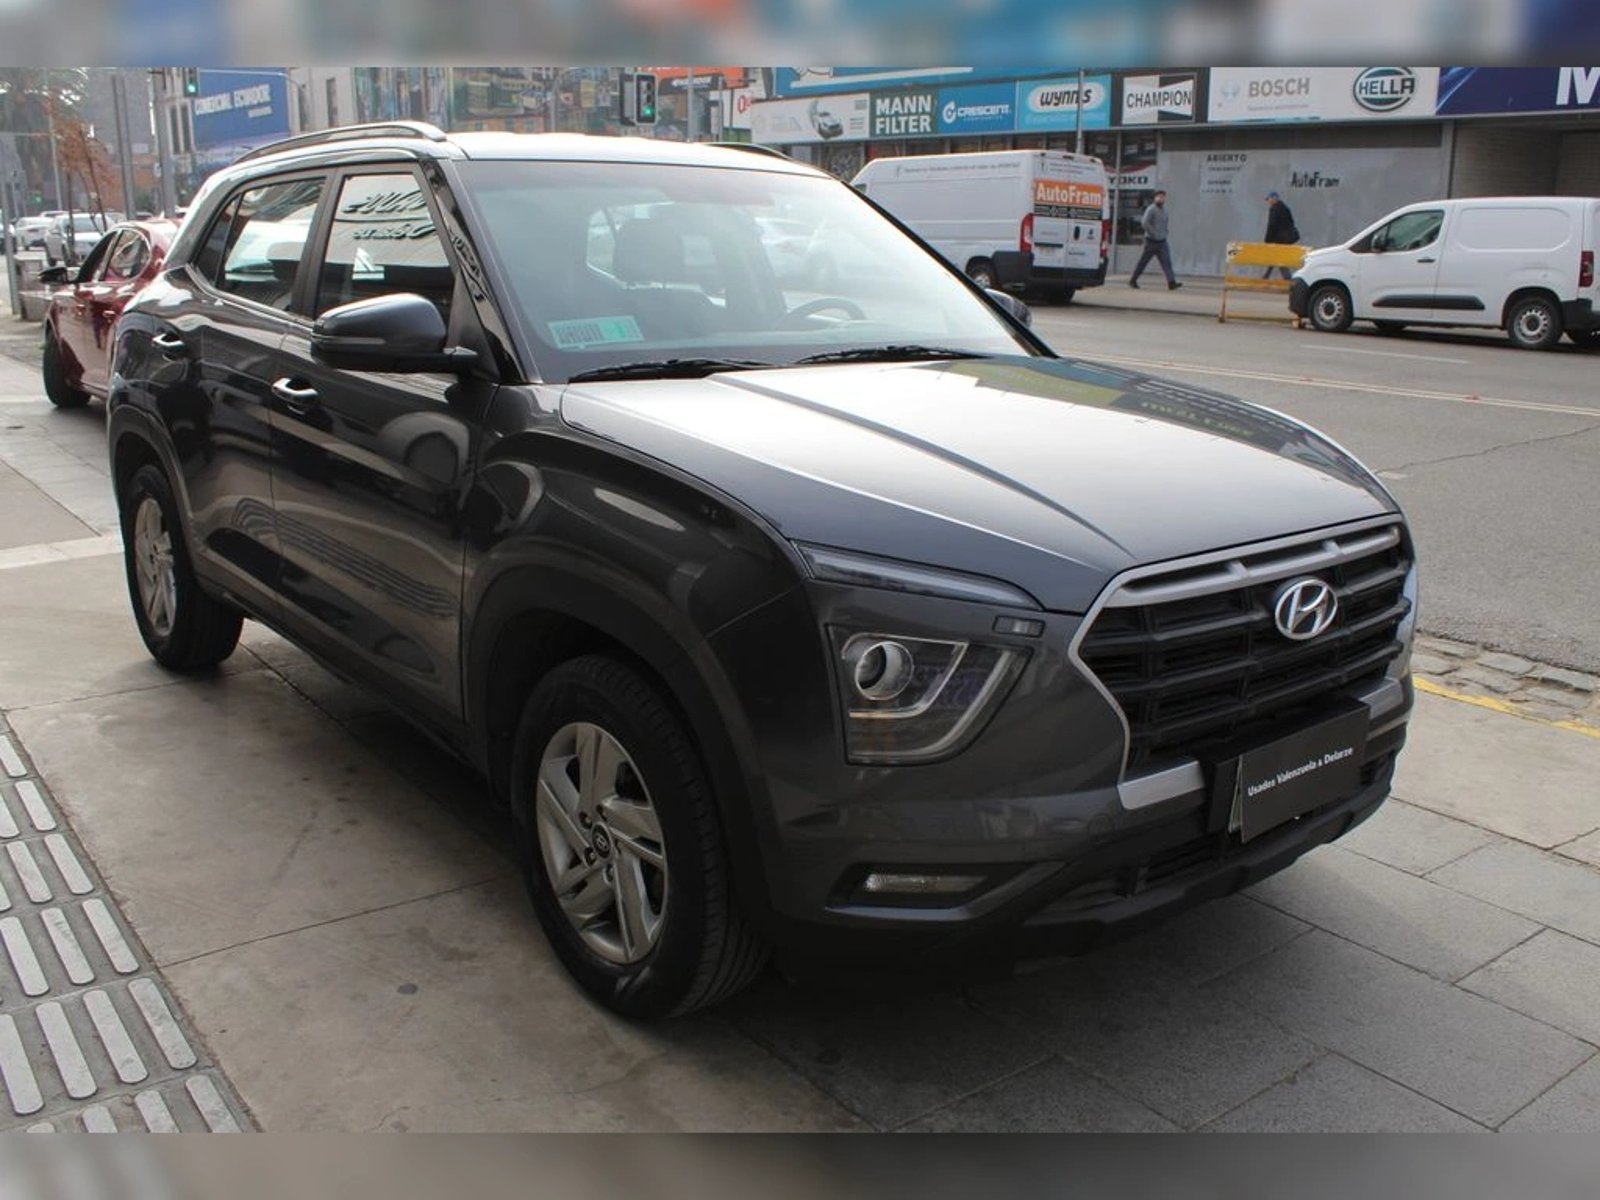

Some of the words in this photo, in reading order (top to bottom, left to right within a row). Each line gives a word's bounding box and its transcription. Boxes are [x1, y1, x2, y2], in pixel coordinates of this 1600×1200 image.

[1248, 77, 1311, 98] BOSCH
[1358, 77, 1415, 96] HELLA
[875, 94, 932, 116] MANN
[1040, 89, 1092, 107] wynns
[1126, 89, 1192, 109] CHAMPION
[957, 104, 1010, 118] CRESCENT
[875, 114, 932, 135] FILTER
[1291, 171, 1340, 189] AutoFram
[1036, 182, 1102, 206] AutoFram
[1248, 779, 1276, 796] Usados
[1276, 760, 1317, 784] Valenzuela
